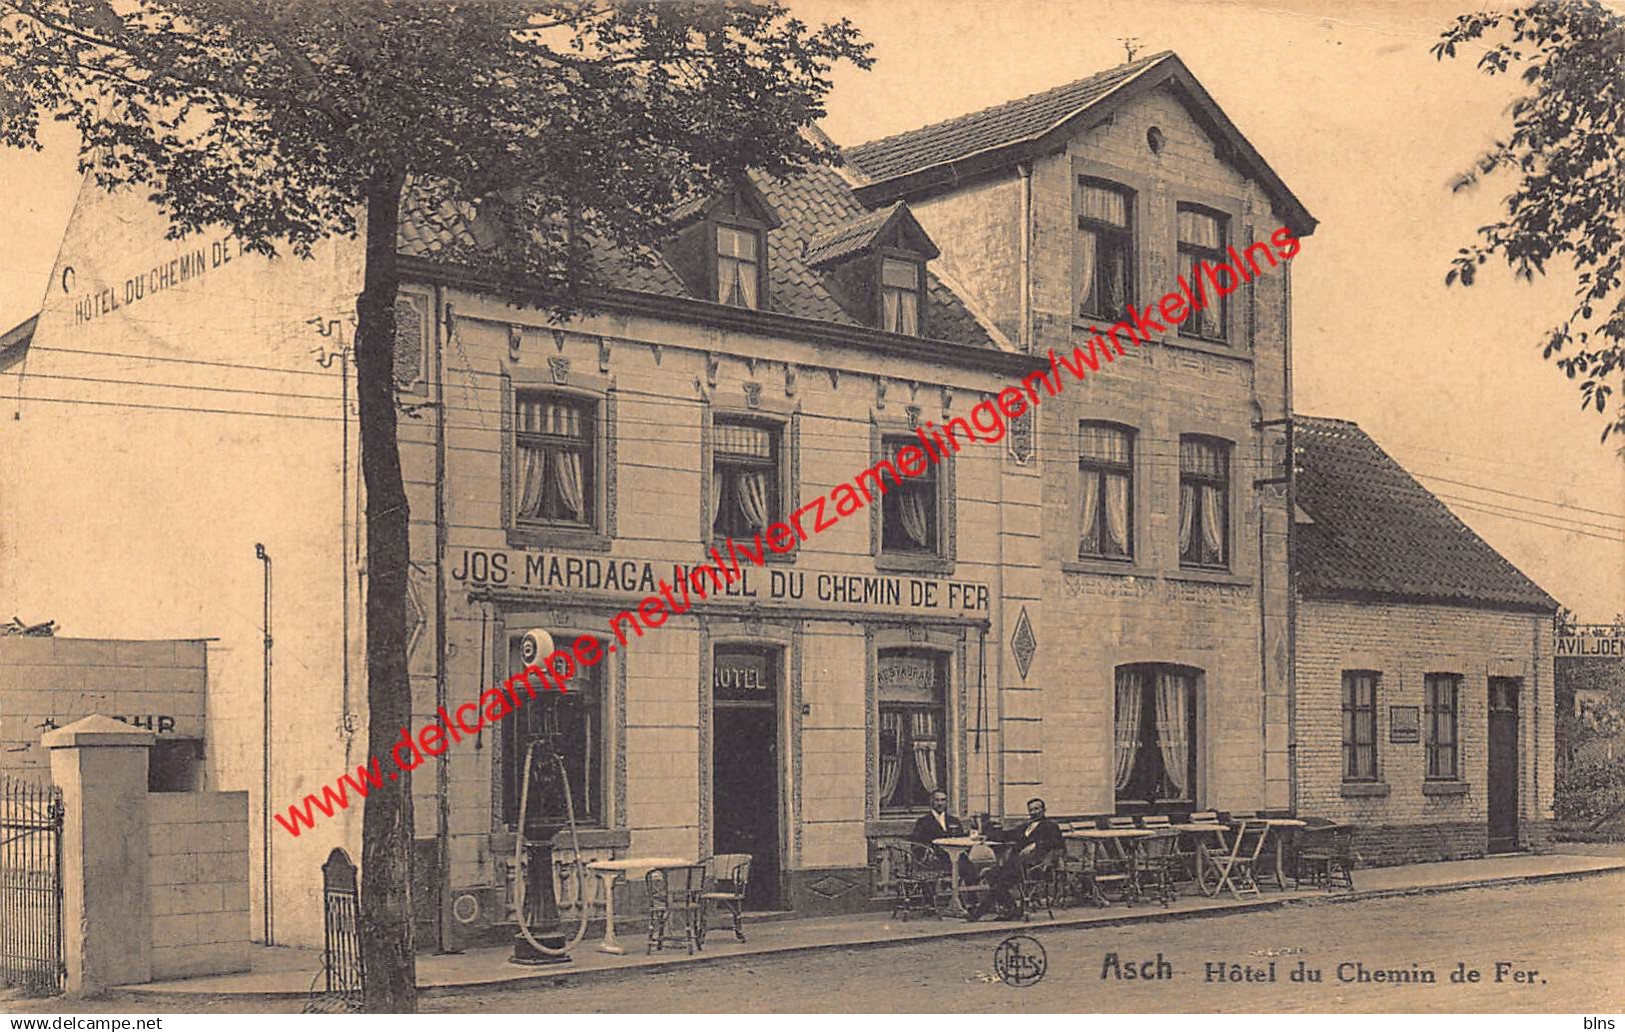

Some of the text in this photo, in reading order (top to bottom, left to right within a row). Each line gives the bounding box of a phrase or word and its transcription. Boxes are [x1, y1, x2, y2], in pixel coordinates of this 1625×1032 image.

[125, 274, 144, 305] DU
[150, 248, 206, 294] CHEMIN
[212, 236, 231, 268] DE
[525, 554, 656, 593] MARDAGA
[770, 570, 804, 600] DU
[817, 574, 900, 606] CHEMIN
[911, 580, 948, 609] DE
[948, 584, 989, 611] FER
